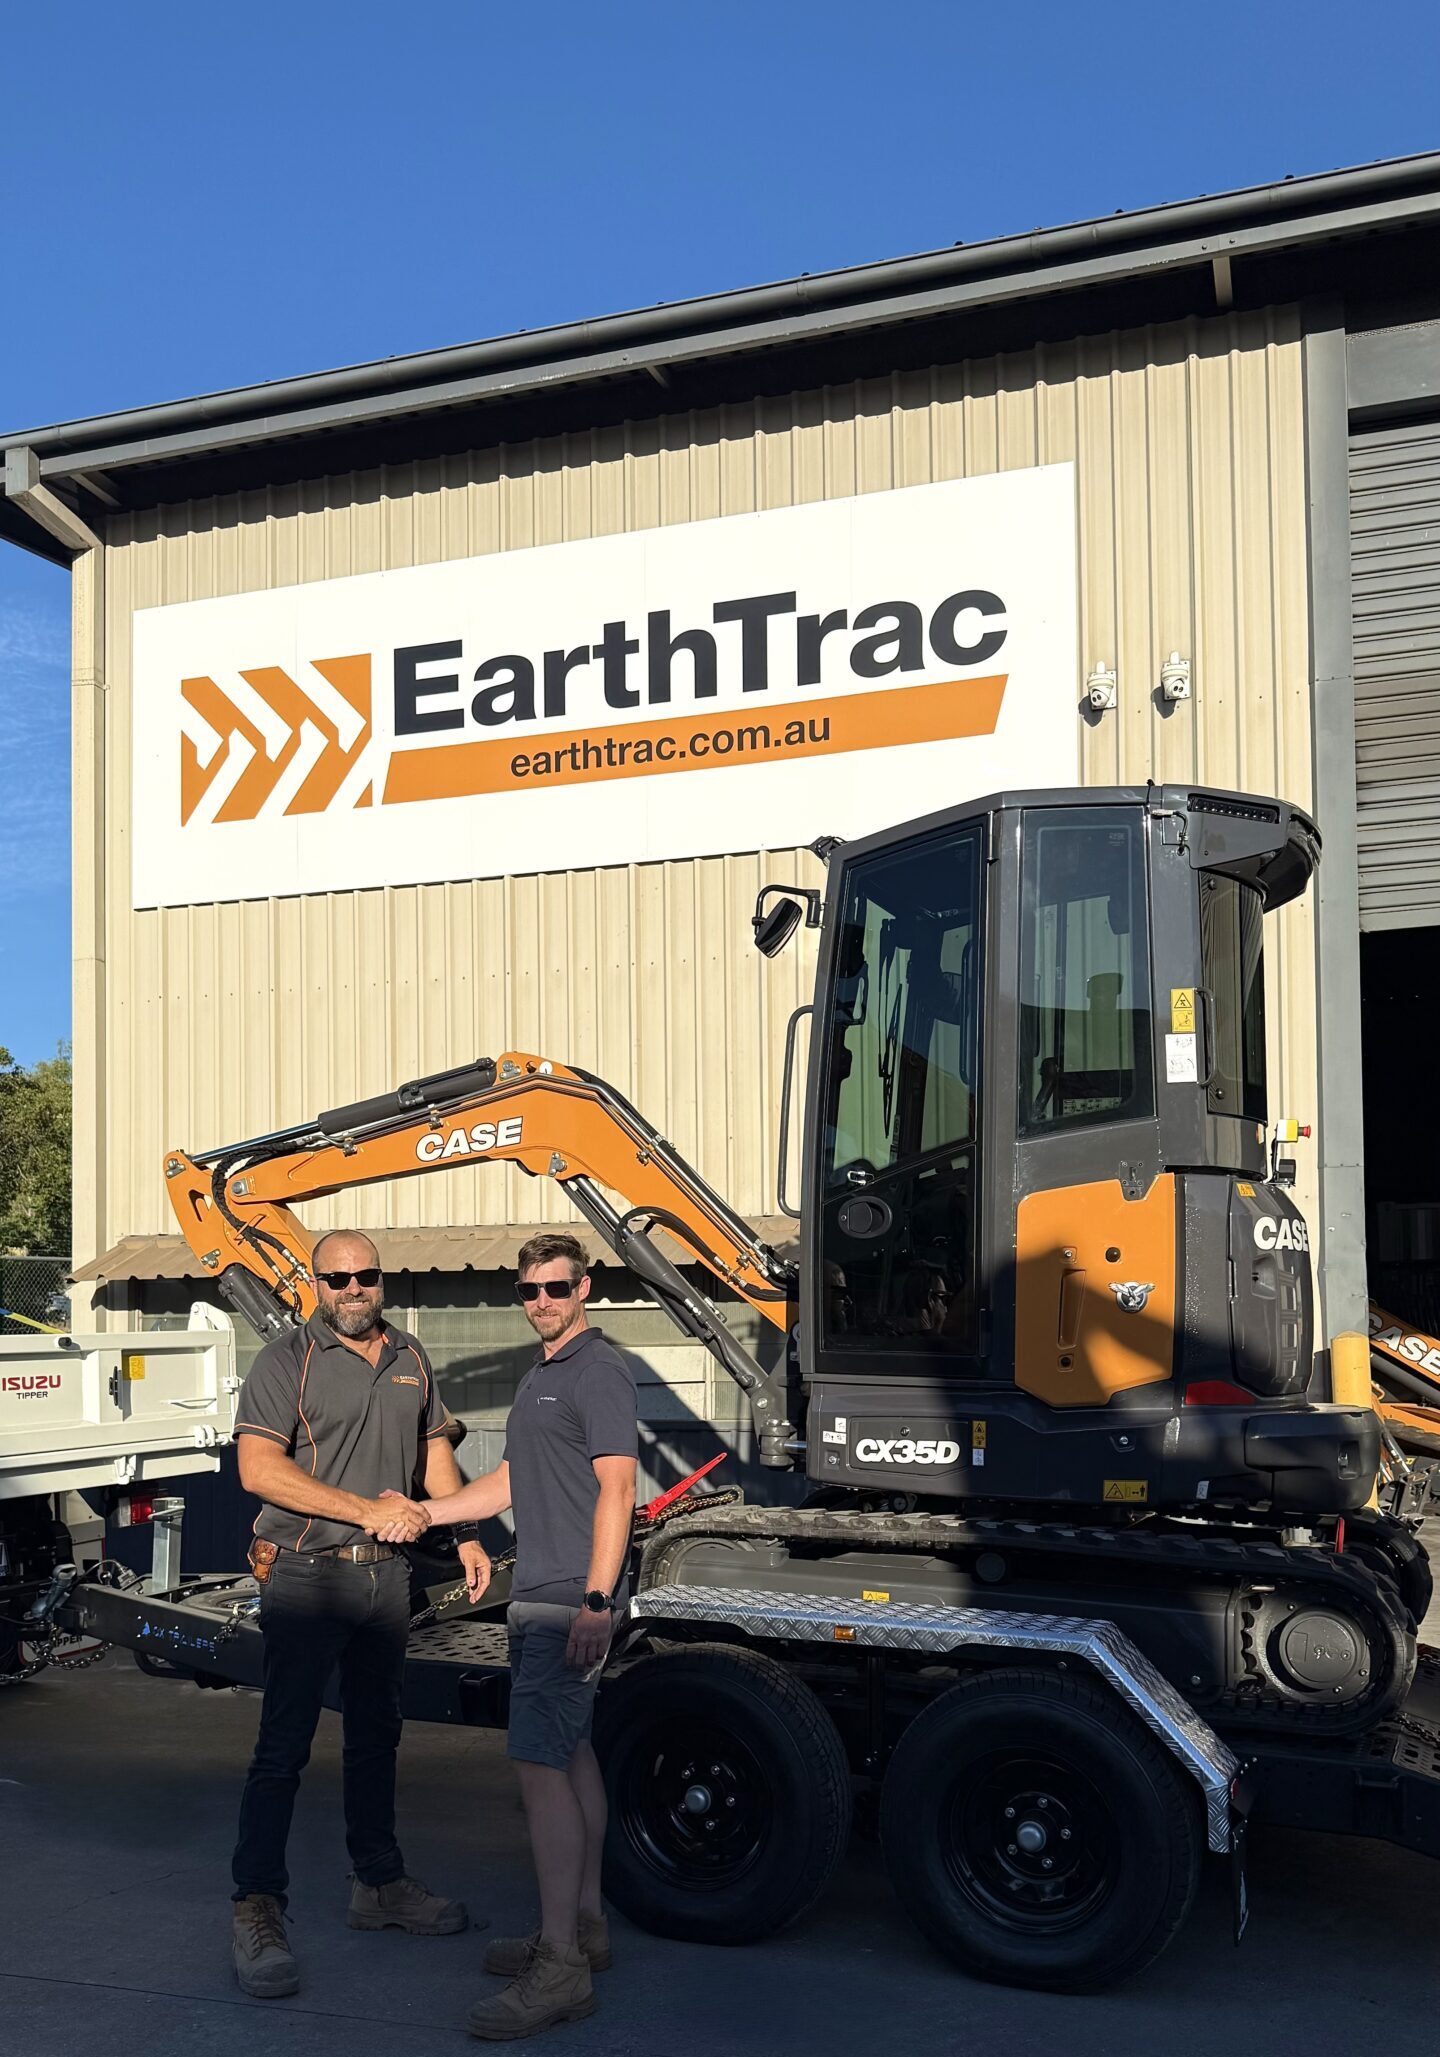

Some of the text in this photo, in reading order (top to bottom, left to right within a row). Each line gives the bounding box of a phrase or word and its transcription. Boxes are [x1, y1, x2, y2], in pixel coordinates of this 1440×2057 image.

[394, 590, 1007, 736] EarthTrac
[511, 716, 830, 777] earthtrac.com.au
[416, 1116, 523, 1162] CASE
[1254, 1217, 1309, 1251] CASE
[2, 1375, 61, 1391] ISUZU
[16, 1391, 48, 1399] TIPPER
[855, 1438, 960, 1465] CX35D
